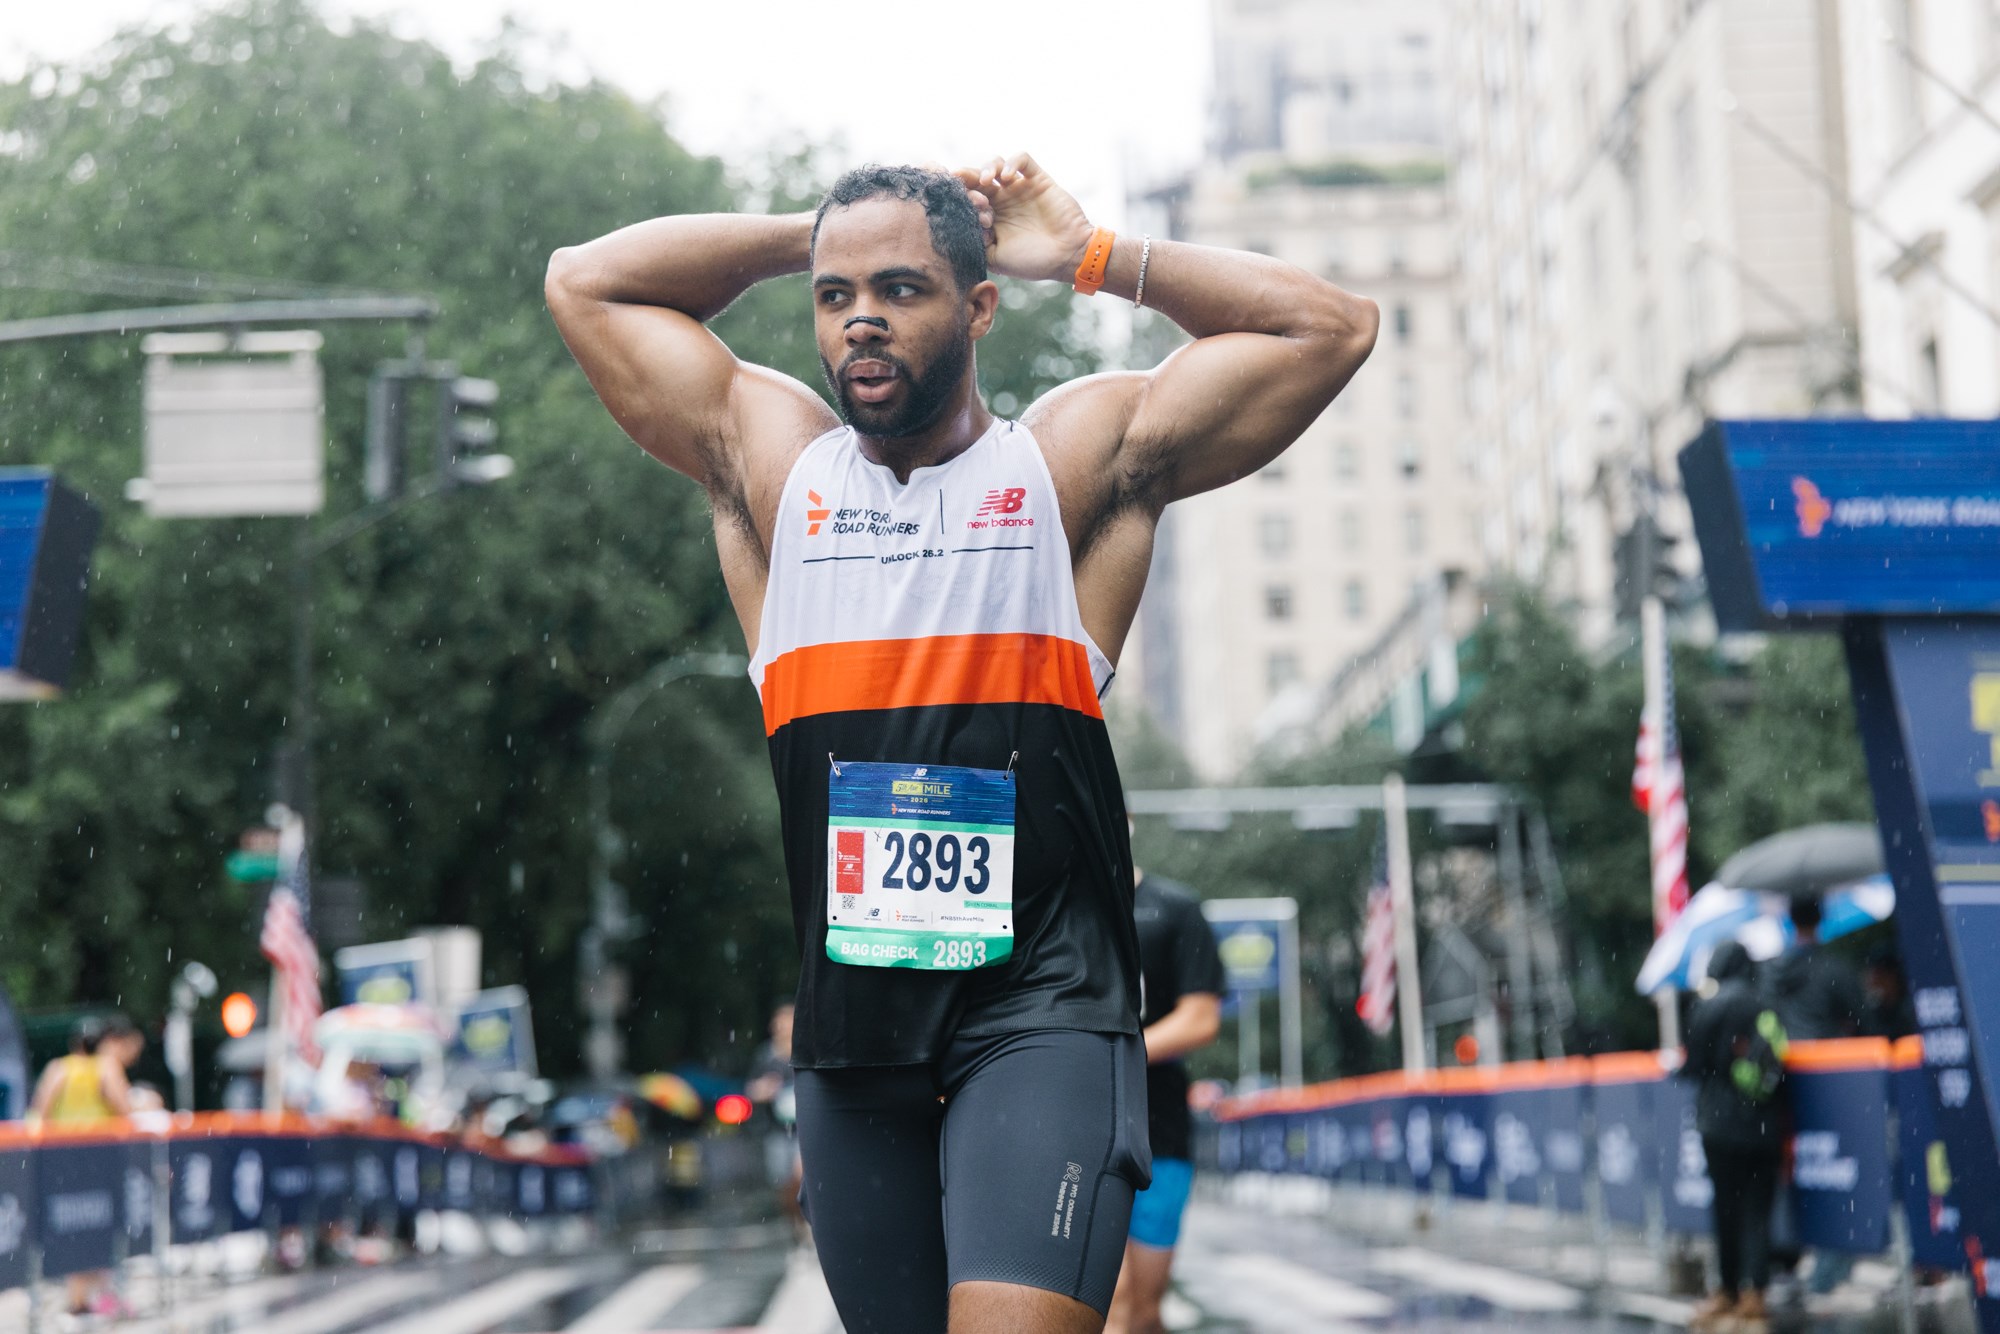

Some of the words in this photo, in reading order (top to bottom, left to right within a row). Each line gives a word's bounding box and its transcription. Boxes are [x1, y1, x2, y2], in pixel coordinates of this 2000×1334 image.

[834, 508, 862, 520] NEW
[831, 521, 865, 534] ROAD
[967, 520, 989, 530] new
[991, 517, 1034, 528] balance
[922, 548, 944, 558] 26.2
[924, 784, 951, 795] MILE
[882, 831, 990, 895] 2893
[840, 941, 870, 956] BAG
[871, 944, 919, 960] CHECK
[932, 940, 987, 968] 2893
